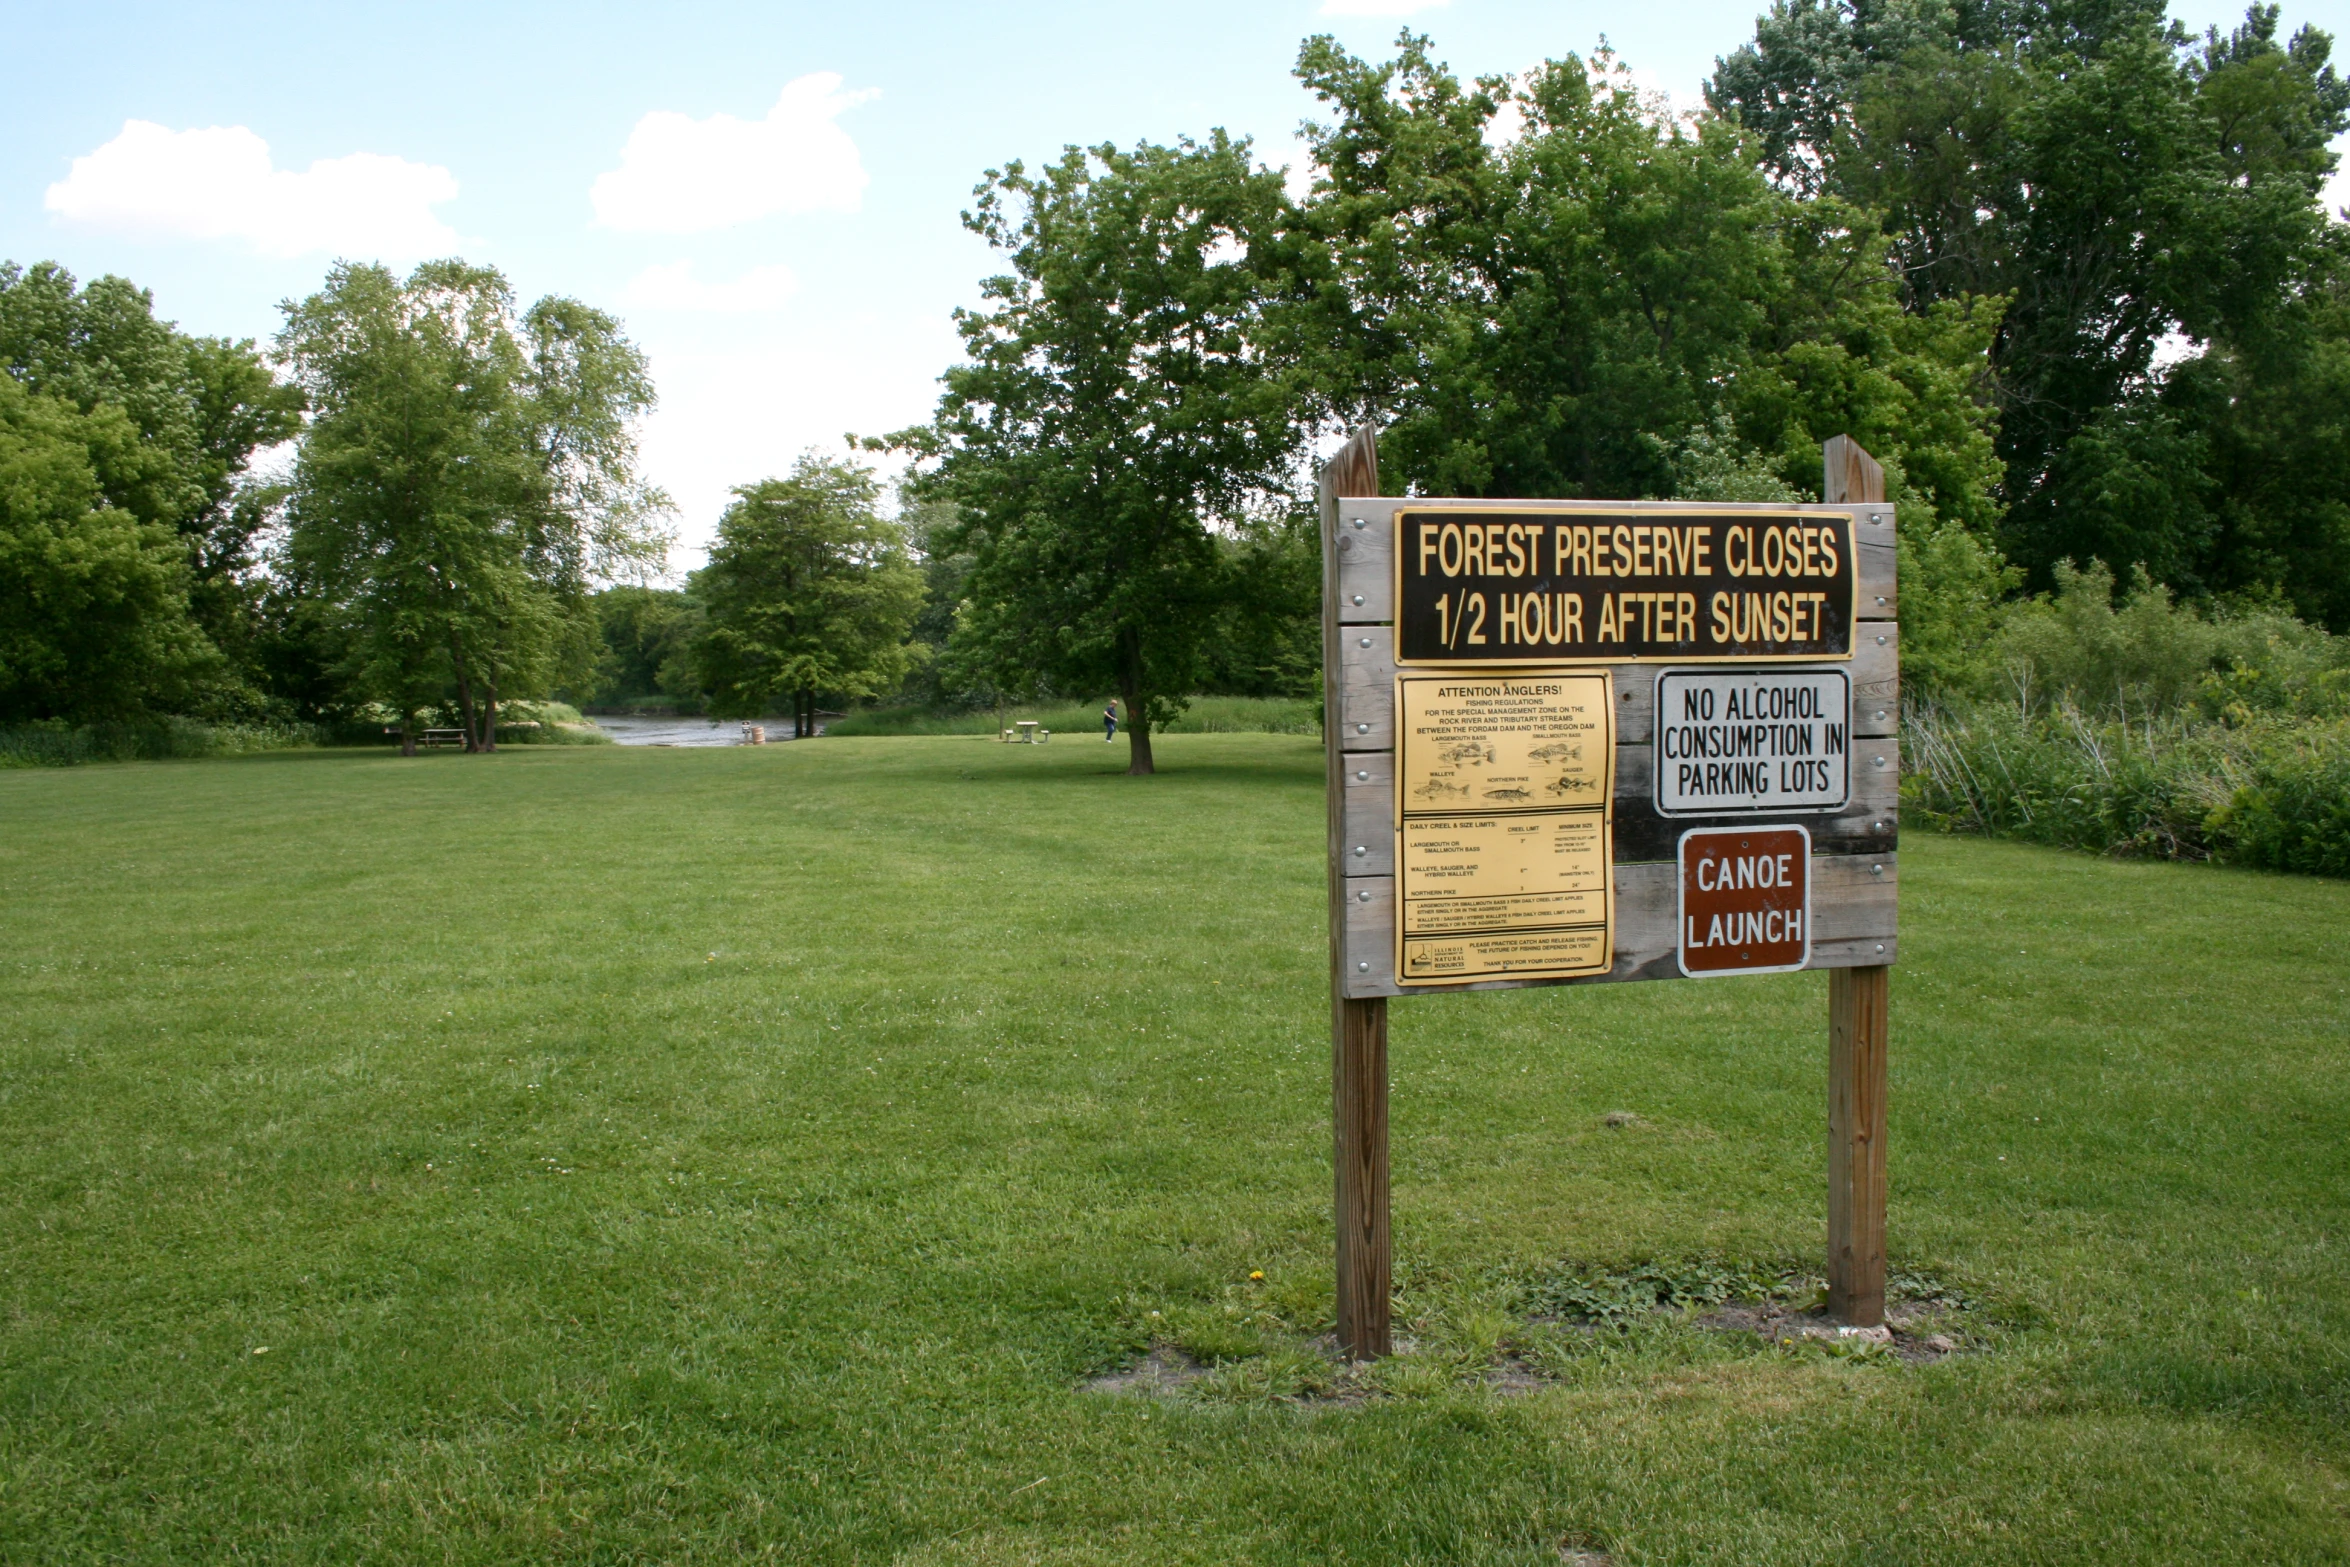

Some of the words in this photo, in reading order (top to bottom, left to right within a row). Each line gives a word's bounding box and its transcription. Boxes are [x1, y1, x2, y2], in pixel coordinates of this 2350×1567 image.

[1419, 523, 1543, 577] FOREST
[1555, 526, 1711, 577] PRESERVE
[1725, 526, 1838, 578] CLOSES
[1435, 588, 1486, 650] 1/2
[1500, 592, 1584, 646] HOUR
[1598, 592, 1696, 642] AFTER
[1711, 591, 1827, 644] SUNSET
[1438, 687, 1500, 697] ATTENTION
[1504, 686, 1562, 696] ANGLERS!
[1684, 688, 1713, 721] NO
[1726, 687, 1824, 720] ALCOHOL
[1665, 724, 1812, 759] CONSUMPTION
[1825, 723, 1842, 755] IN
[1678, 761, 1768, 796] PARKING
[1781, 760, 1828, 793] LOTS
[1698, 854, 1792, 891] CANOE
[1688, 909, 1801, 948] LAUNCH
